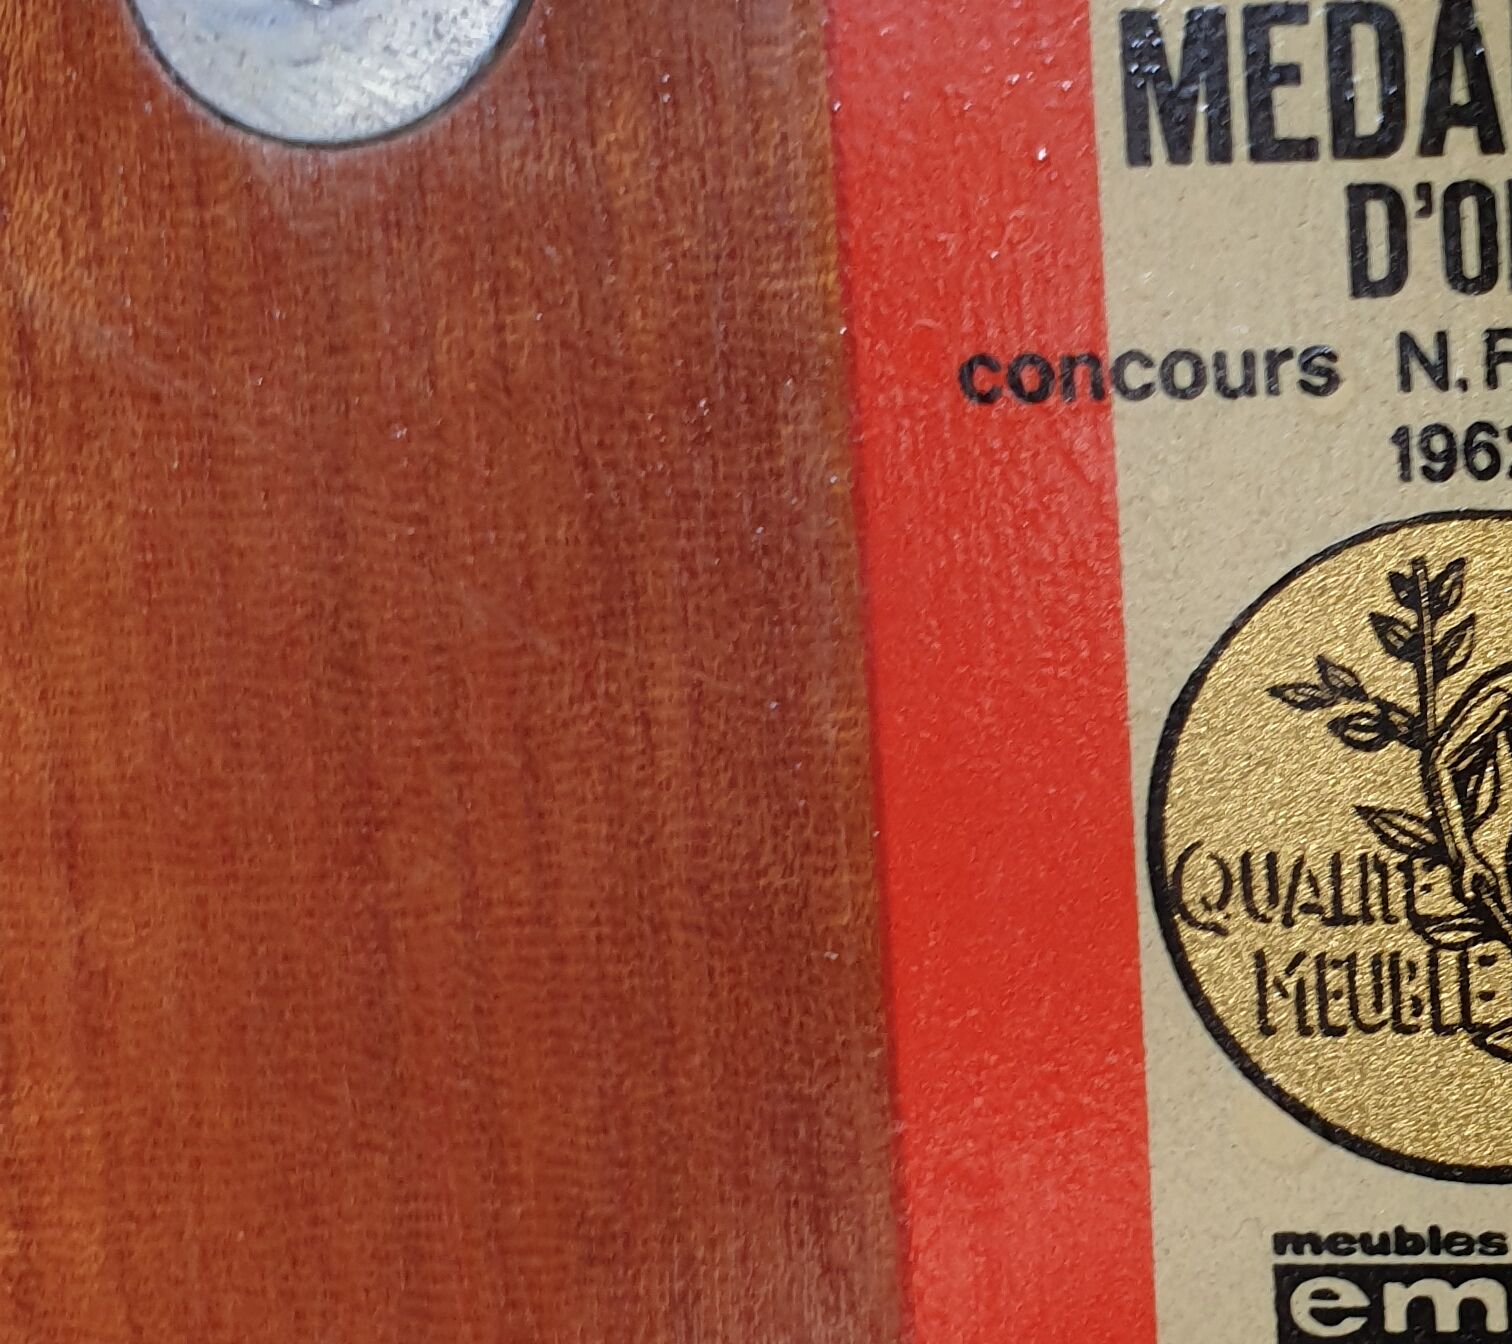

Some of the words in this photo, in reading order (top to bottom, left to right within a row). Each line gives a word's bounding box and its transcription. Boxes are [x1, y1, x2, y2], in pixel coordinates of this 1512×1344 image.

[957, 341, 1341, 406] concours
[1254, 950, 1498, 1037] MEUBLE
[1272, 1224, 1509, 1256] meubles
